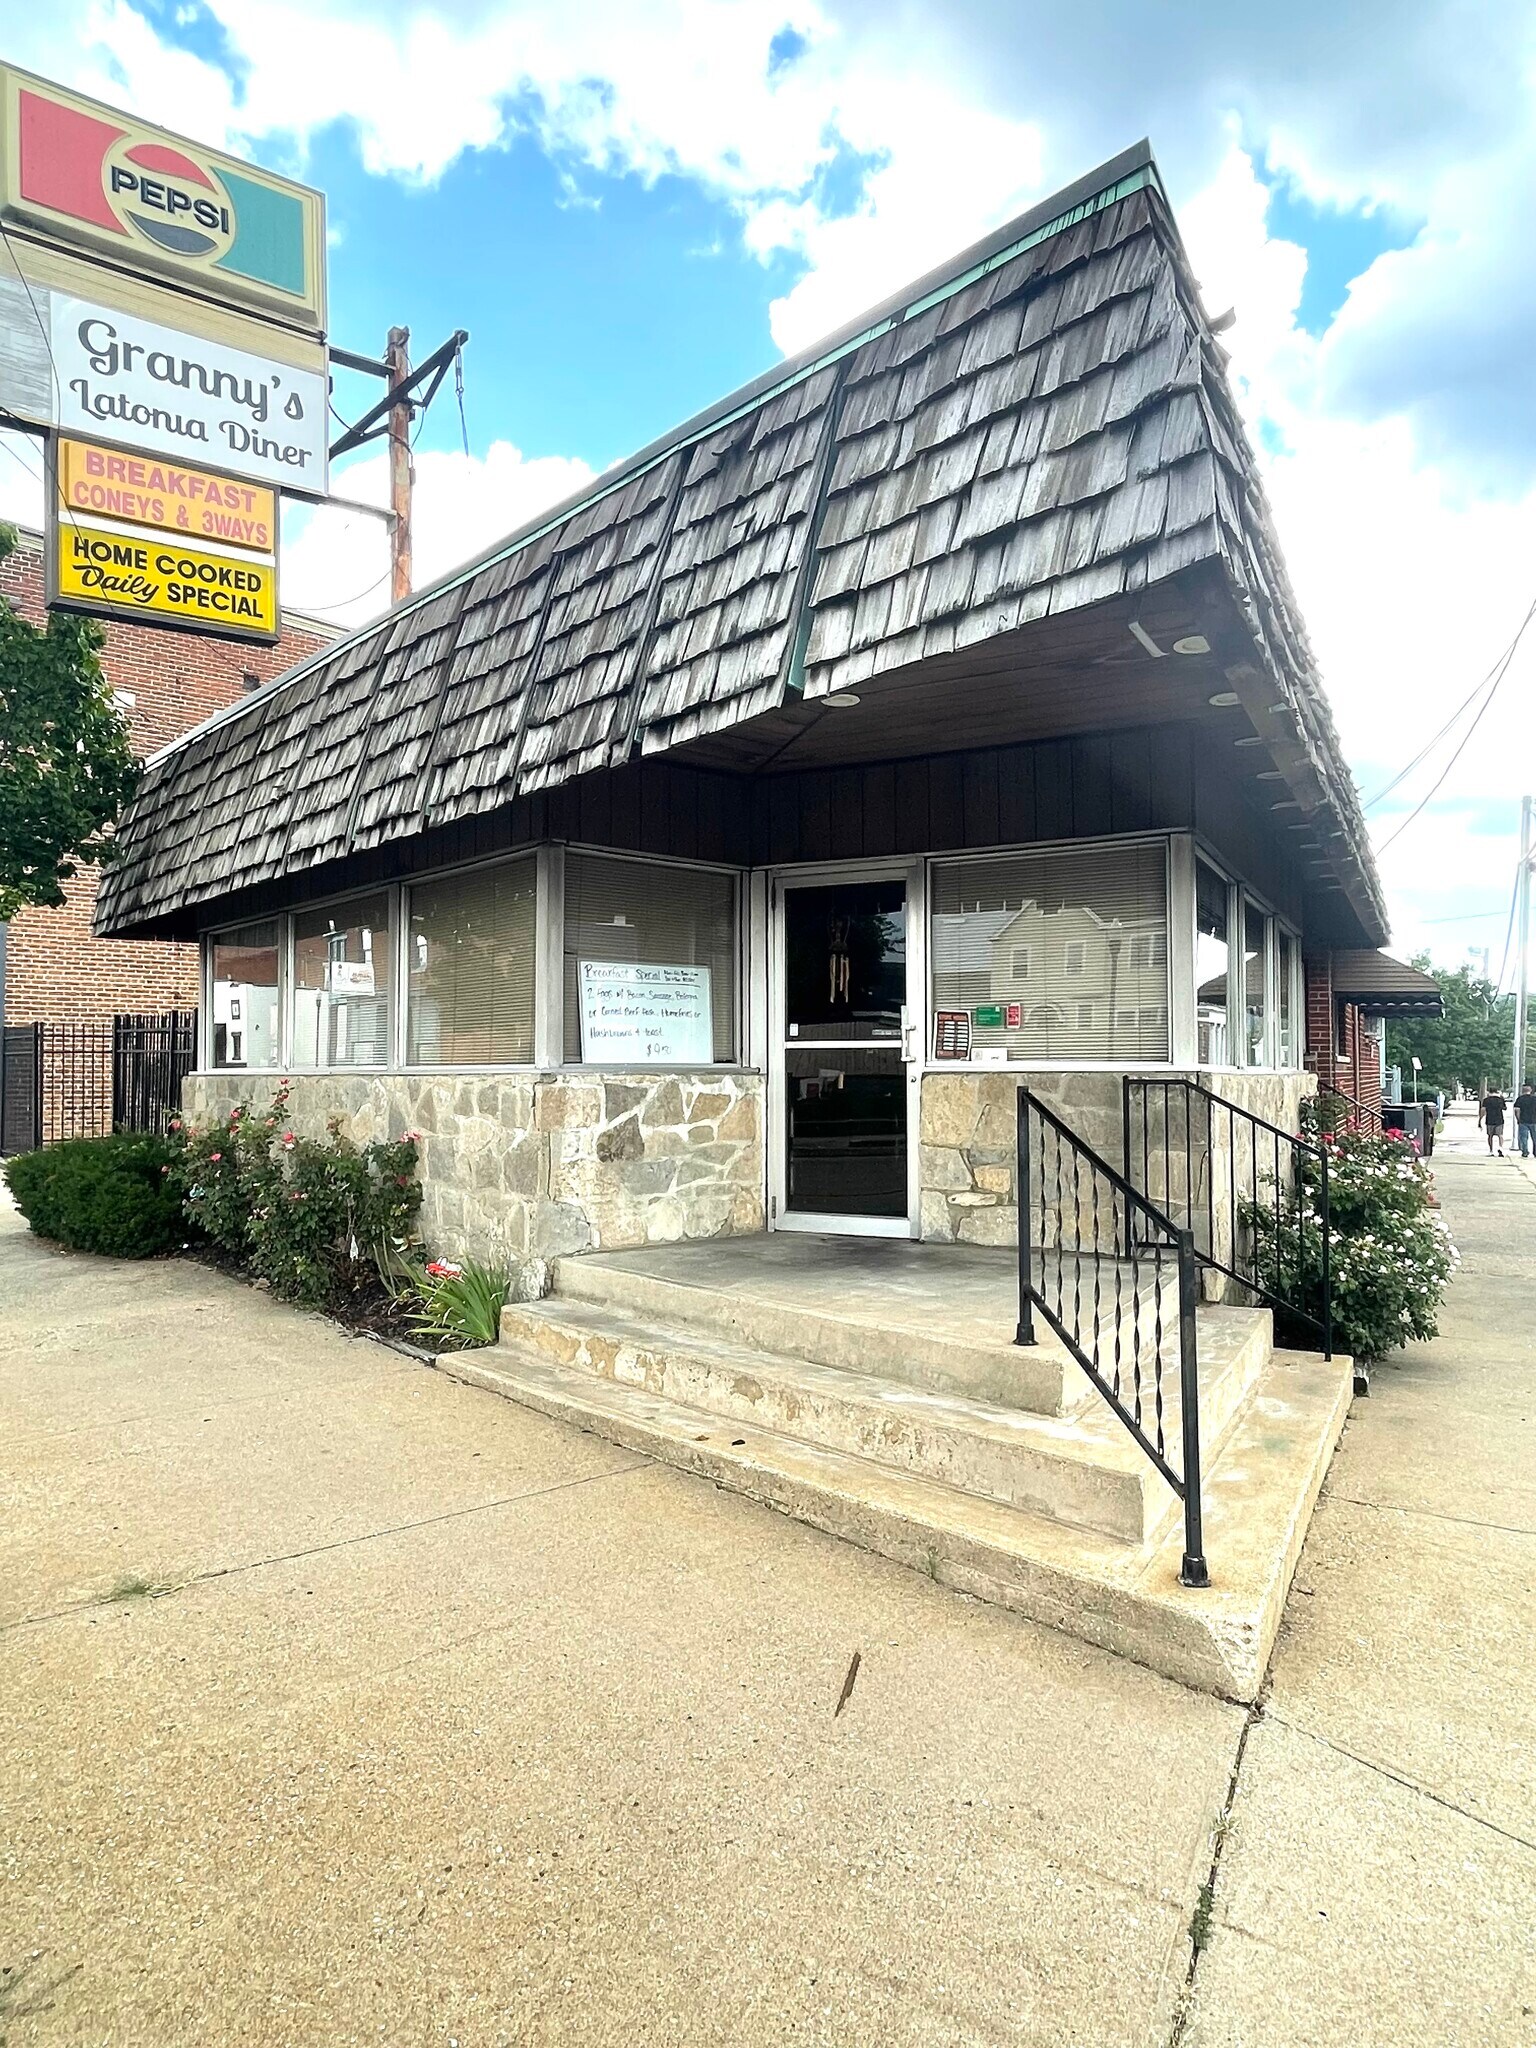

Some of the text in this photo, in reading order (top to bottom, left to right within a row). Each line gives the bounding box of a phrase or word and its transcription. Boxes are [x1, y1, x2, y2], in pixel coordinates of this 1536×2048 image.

[111, 165, 229, 235] PEPSI
[78, 319, 304, 422] Granny's
[69, 379, 313, 468] Latonia Diner
[74, 481, 268, 545] CONEYS & 3WAYS
[86, 450, 257, 513] BREAKFAST
[73, 565, 264, 619] Daily SPECIAL
[74, 536, 262, 593] HOME COOKED
